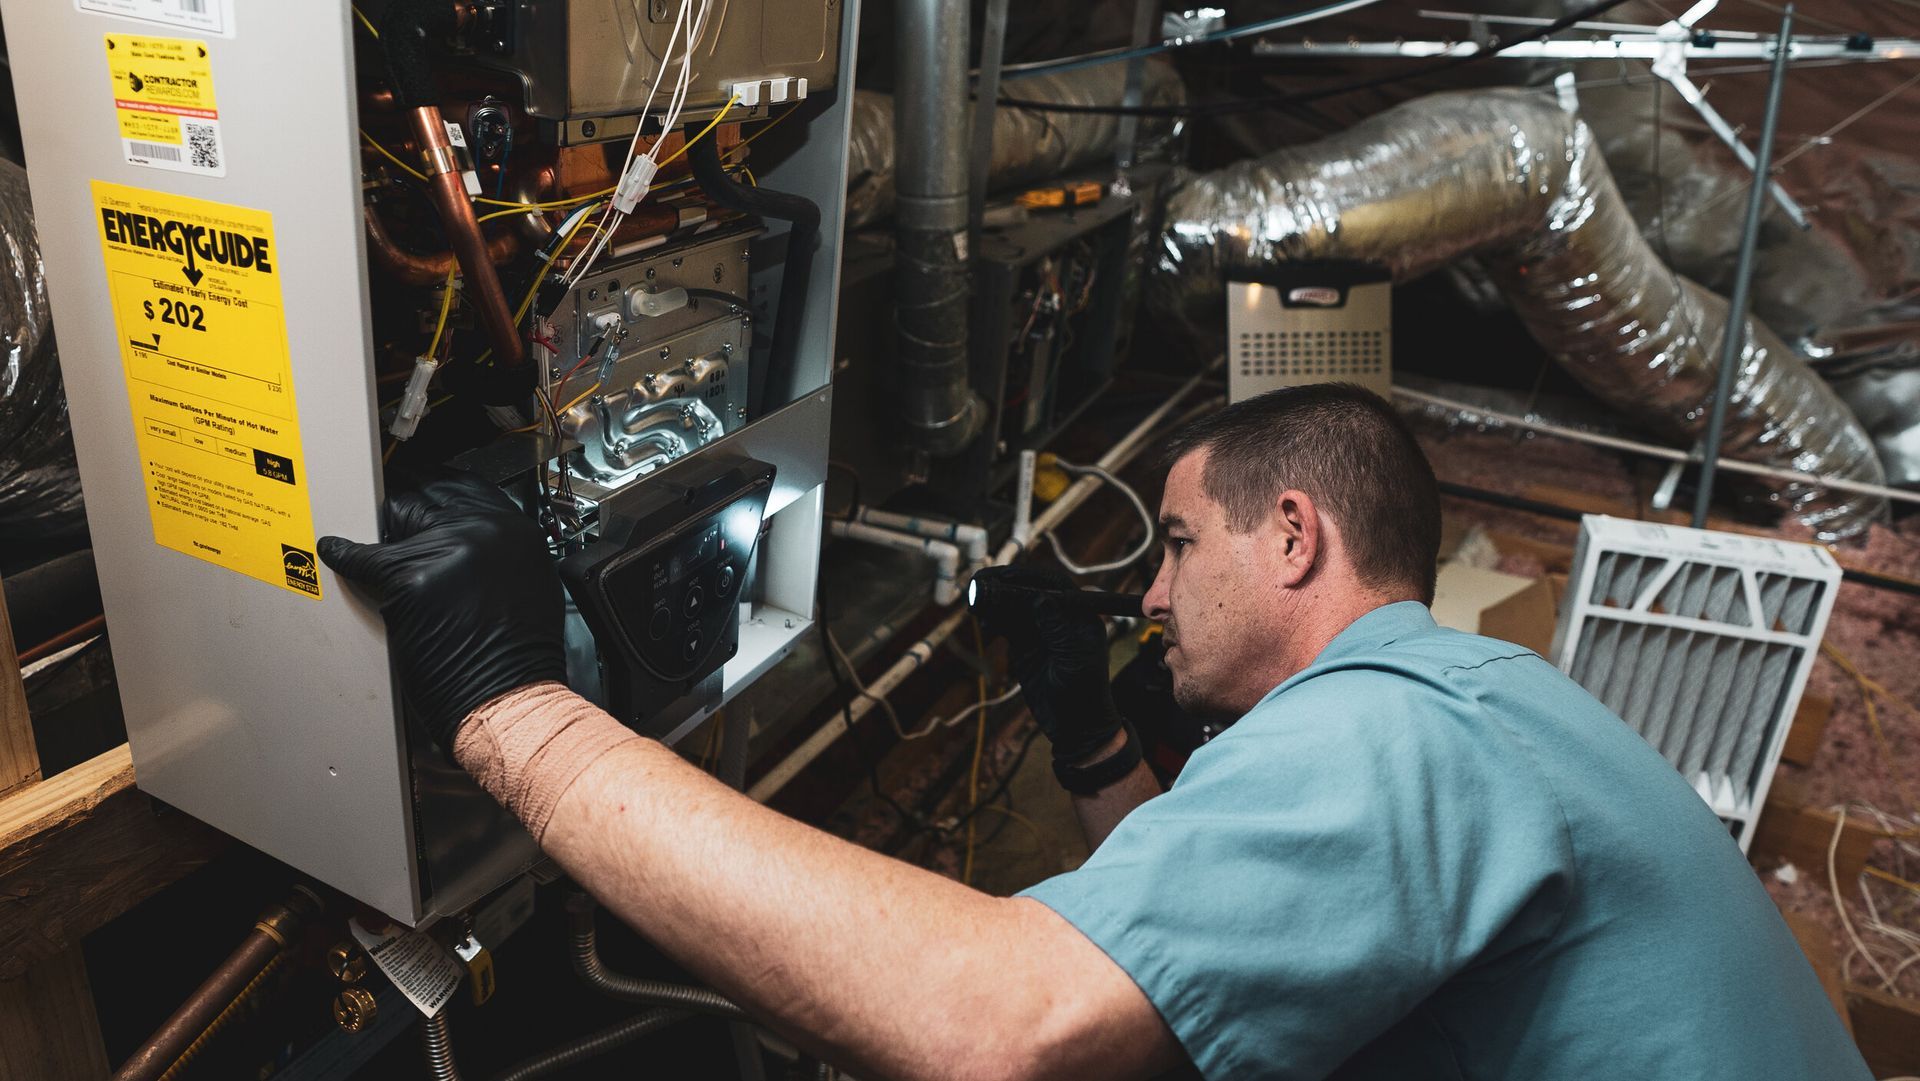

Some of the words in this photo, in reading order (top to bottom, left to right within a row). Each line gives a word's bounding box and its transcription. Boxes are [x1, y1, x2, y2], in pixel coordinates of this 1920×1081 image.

[144, 75, 197, 88] CONTRACTOR
[145, 85, 200, 98] REWARDS.COM
[101, 208, 272, 274] ENERGYGUIDE
[152, 279, 184, 294] Estimated
[186, 286, 206, 300] Yearly
[207, 291, 231, 306] Energy
[232, 296, 248, 308] Cost
[142, 298, 155, 322] $
[157, 296, 206, 332] 202
[149, 393, 178, 408] Maximum
[179, 401, 202, 414] Gallons
[203, 408, 214, 418] Per
[215, 411, 236, 424] Minute
[238, 417, 245, 426] of
[245, 419, 257, 429] Hot
[258, 423, 278, 435] Water
[149, 424, 161, 434] very
[161, 427, 176, 437] small
[192, 415, 210, 428] (GPM
[211, 420, 236, 436] Rating)
[193, 436, 204, 445] low
[223, 445, 247, 458] medium
[266, 457, 281, 469] high
[272, 470, 288, 481] GPM
